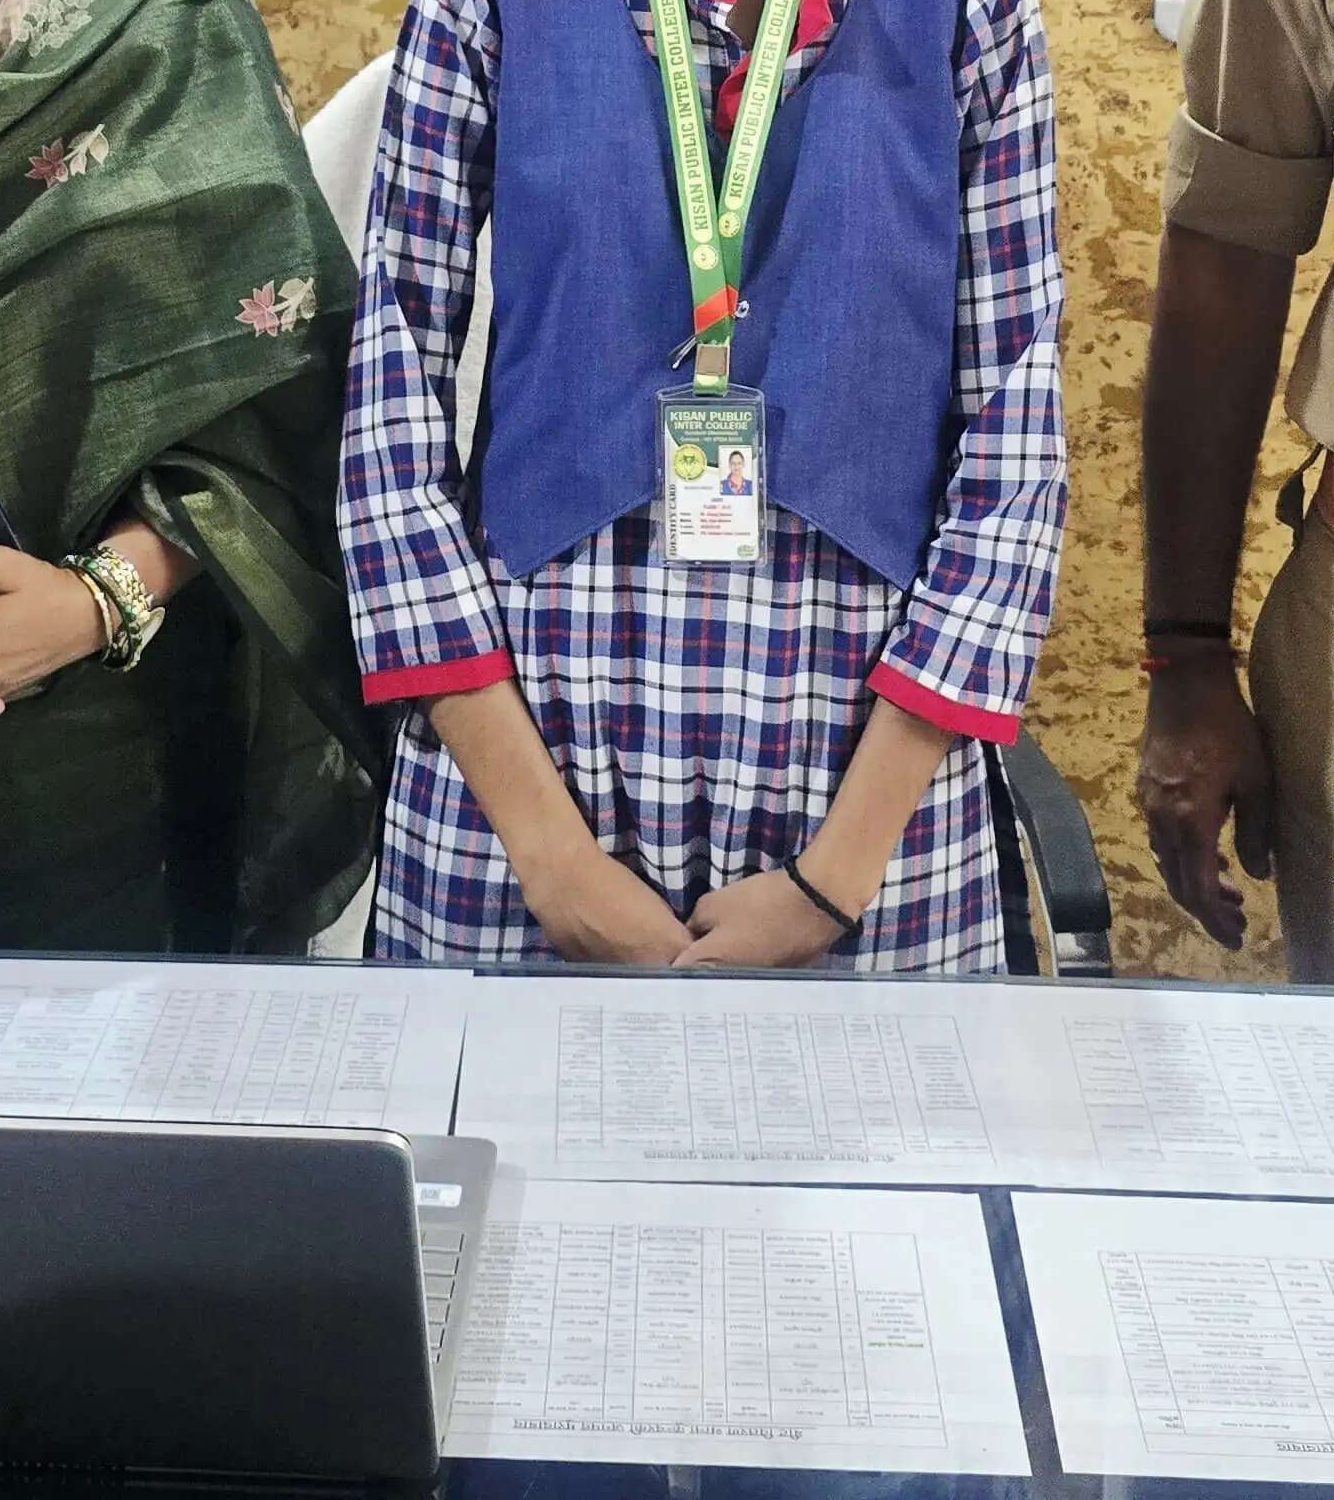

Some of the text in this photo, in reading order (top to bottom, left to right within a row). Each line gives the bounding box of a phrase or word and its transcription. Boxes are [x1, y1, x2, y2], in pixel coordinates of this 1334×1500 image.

[673, 69, 693, 118] INTER
[729, 151, 753, 199] KISAN
[741, 91, 766, 148] PUBLIC
[755, 40, 779, 90] INTER
[679, 122, 702, 178] PUBLIC
[688, 183, 709, 232] KISAN
[674, 421, 748, 430] INTER COLLEGE
[709, 411, 752, 421] PUBLIC
